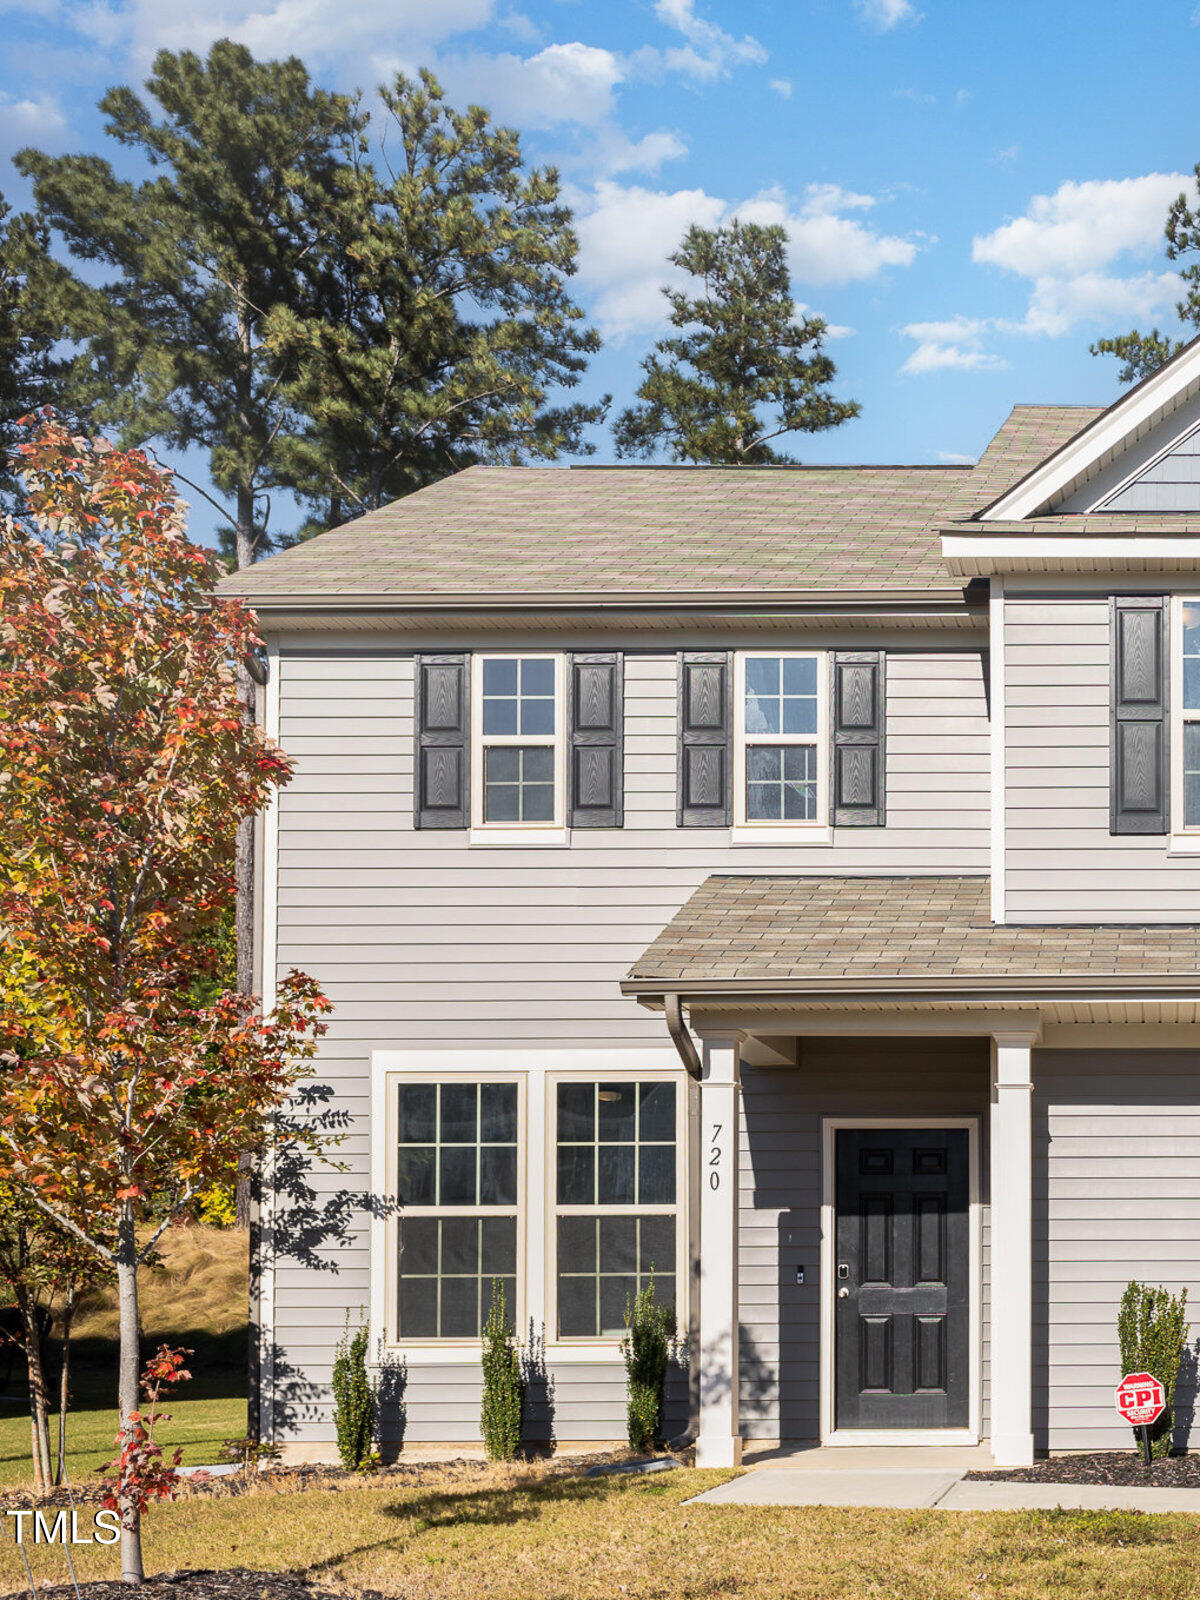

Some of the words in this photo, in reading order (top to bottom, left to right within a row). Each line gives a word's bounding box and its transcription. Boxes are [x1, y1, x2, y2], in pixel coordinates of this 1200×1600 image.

[709, 1124, 722, 1191] 720
[1119, 1389, 1161, 1409] CPI
[1126, 1407, 1155, 1417] SECURITY
